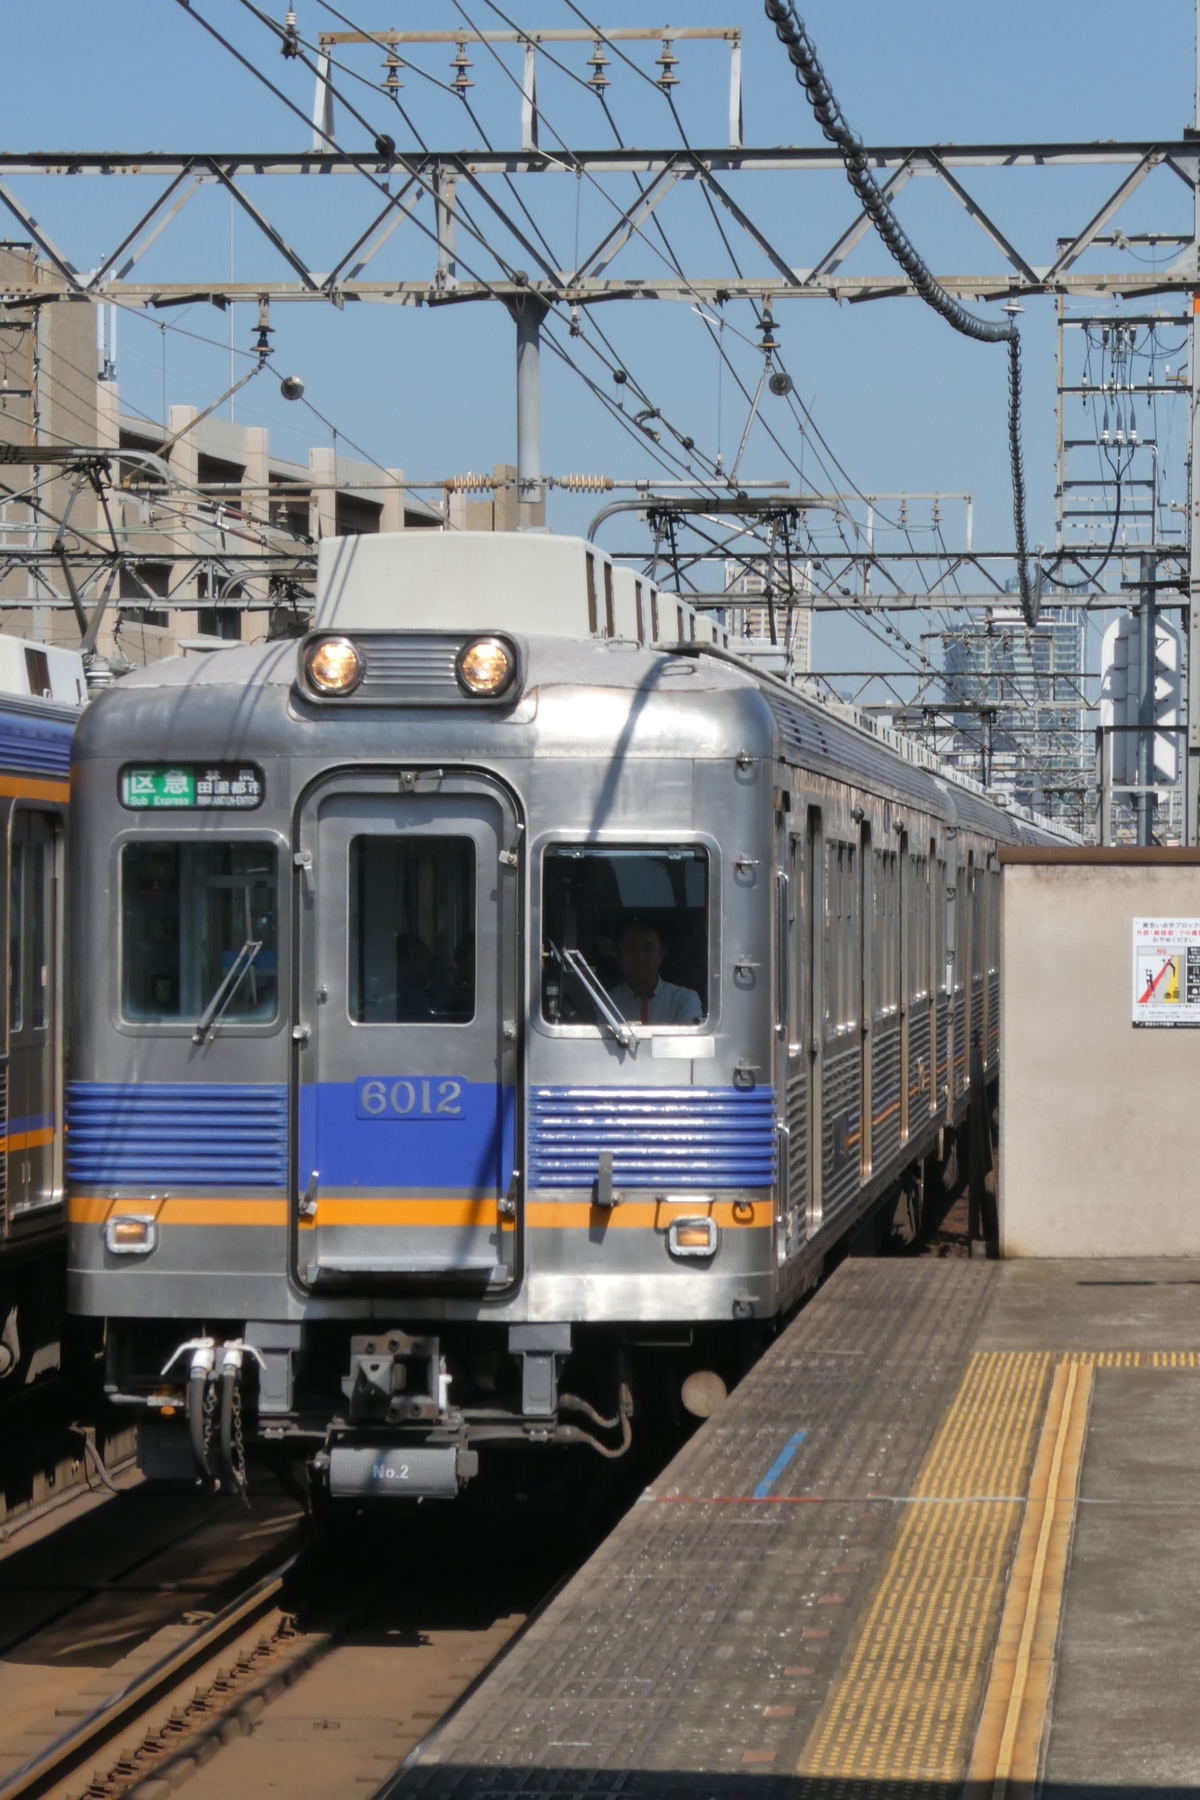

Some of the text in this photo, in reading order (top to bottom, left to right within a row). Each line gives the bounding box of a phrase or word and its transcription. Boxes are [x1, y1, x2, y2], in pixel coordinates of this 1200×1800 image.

[131, 769, 189, 794] 区急
[130, 796, 190, 806] Sub Express
[361, 1081, 461, 1114] 6012
[372, 1464, 409, 1479] No.2
